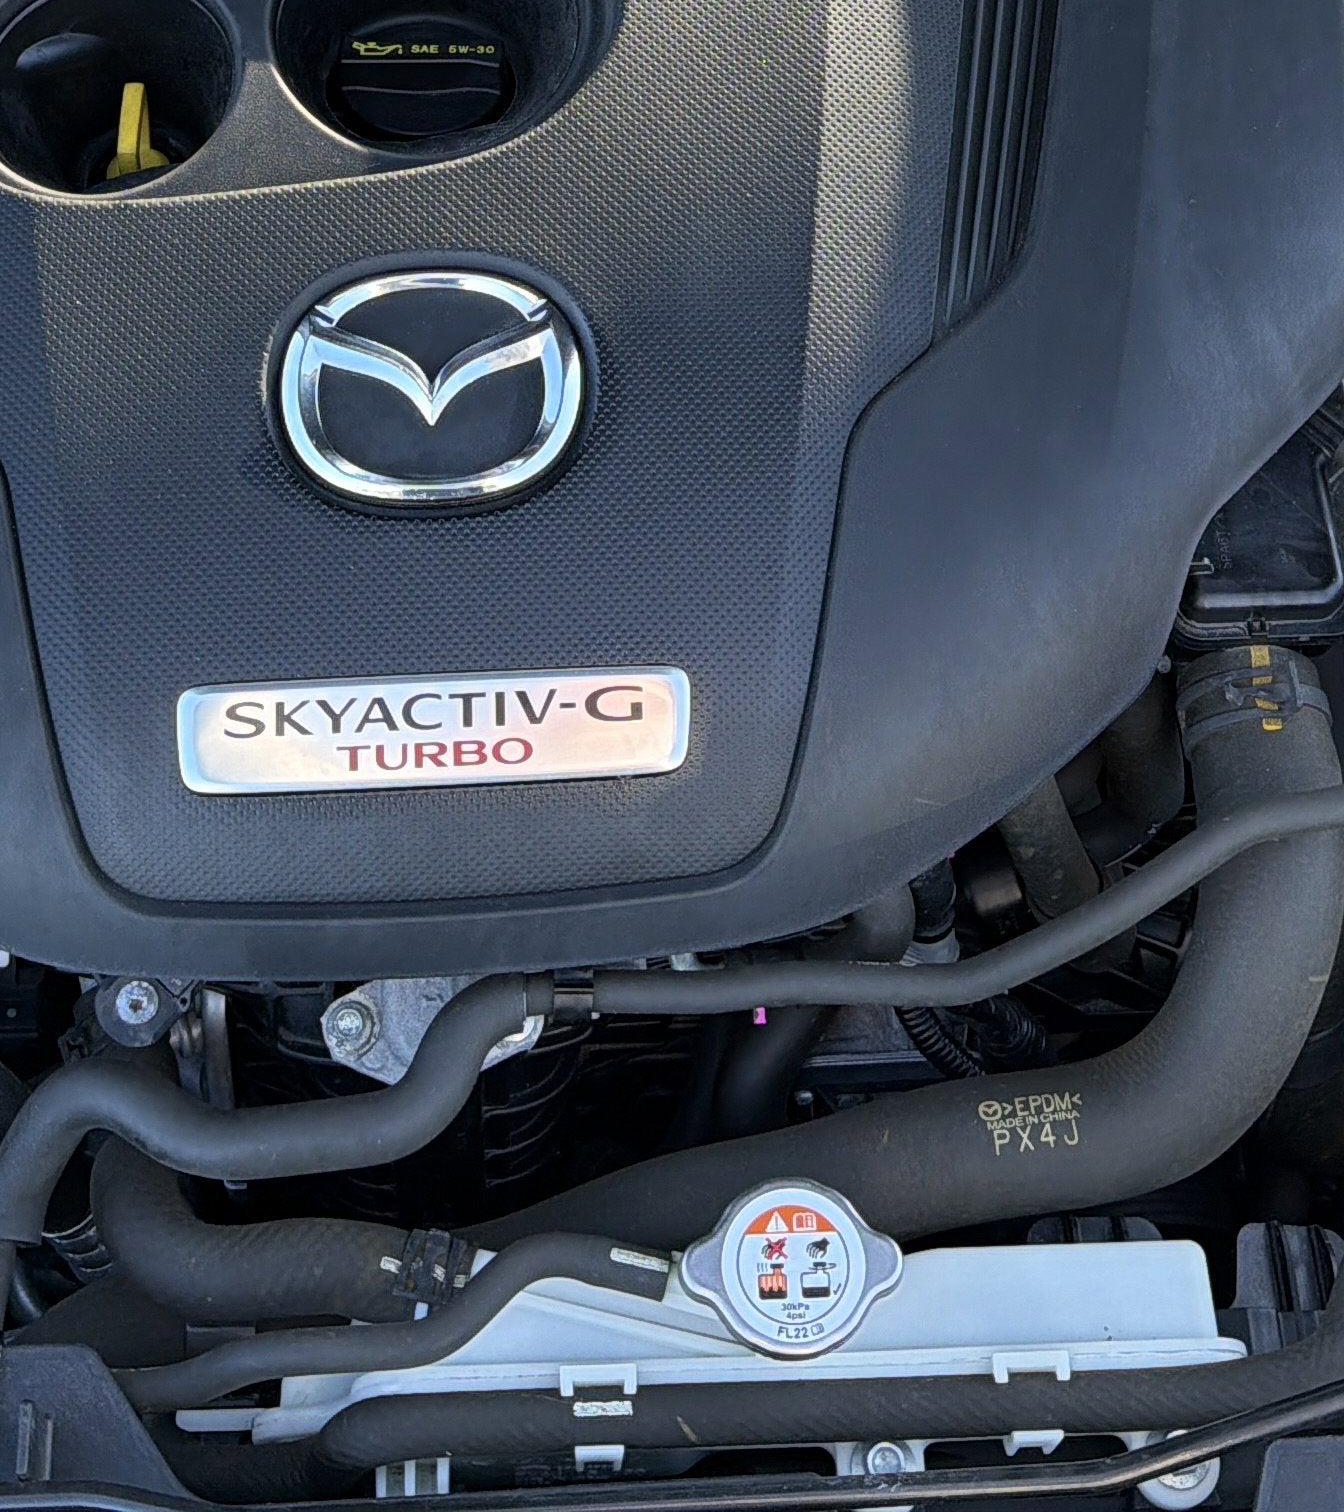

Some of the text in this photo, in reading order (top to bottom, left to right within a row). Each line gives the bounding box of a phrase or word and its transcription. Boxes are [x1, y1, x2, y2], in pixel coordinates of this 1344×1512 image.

[410, 44, 495, 54] SAE 5W-30
[223, 685, 644, 739] SKYACTIV-G
[336, 737, 534, 772] TURBO
[1002, 1091, 1083, 1116] >EPDM<
[987, 1109, 1081, 1130] MADE IN CHINA
[780, 1301, 811, 1312] 30kPa
[785, 1312, 807, 1321] 4psi
[776, 1324, 809, 1339] FL22
